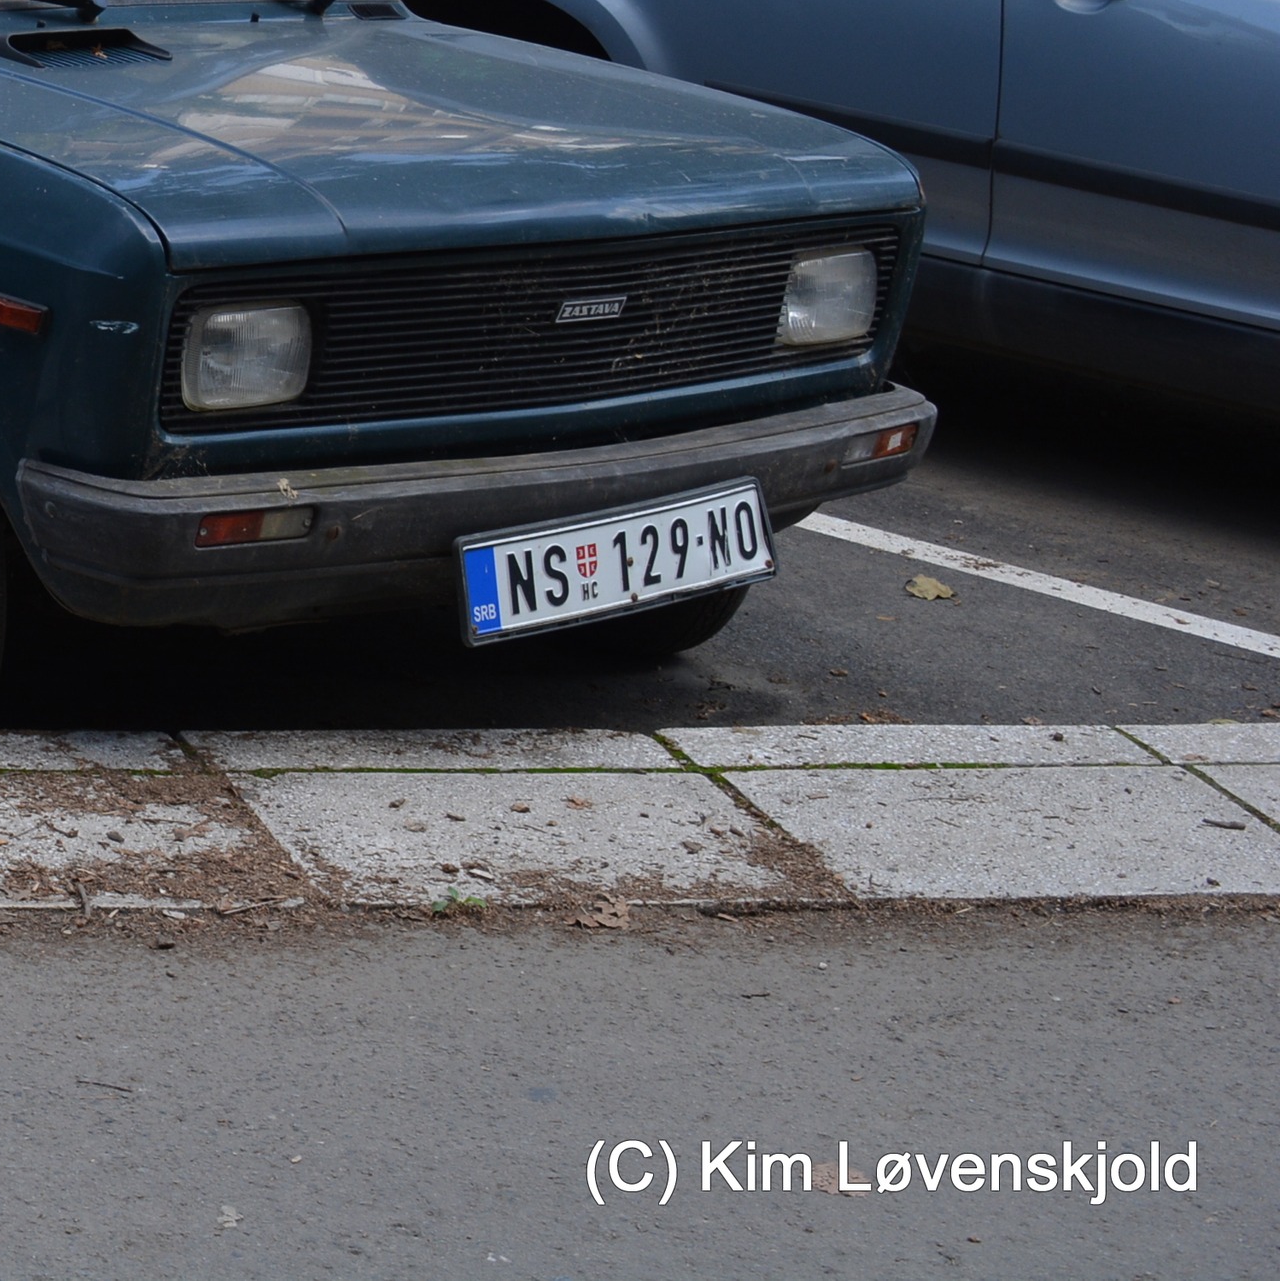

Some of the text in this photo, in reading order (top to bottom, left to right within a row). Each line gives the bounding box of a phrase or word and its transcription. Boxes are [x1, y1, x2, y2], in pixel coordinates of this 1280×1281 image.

[561, 302, 620, 318] ZASTAVA
[506, 544, 570, 615] NS
[473, 603, 497, 623] SRB
